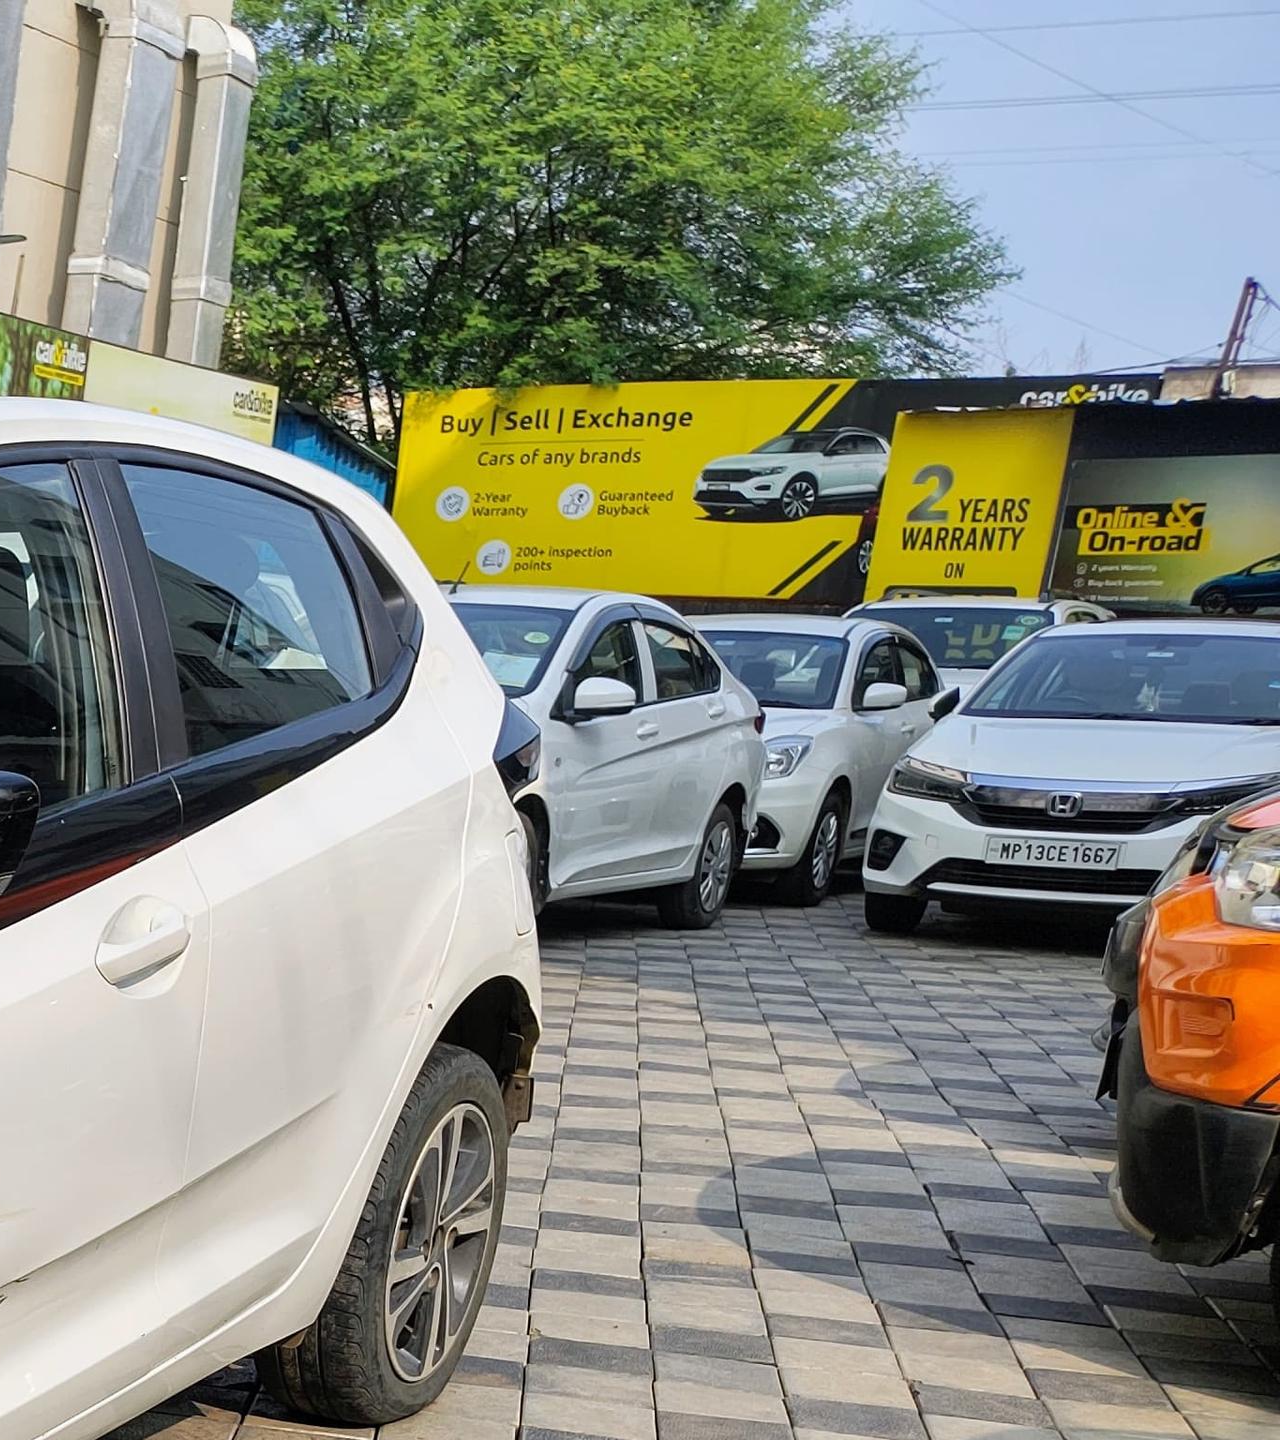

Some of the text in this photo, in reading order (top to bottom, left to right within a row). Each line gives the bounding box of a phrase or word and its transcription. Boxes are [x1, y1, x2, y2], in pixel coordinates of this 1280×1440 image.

[36, 338, 86, 372] car&bike
[441, 415, 484, 437] Buy
[504, 409, 550, 431] Sell
[572, 407, 693, 432] Exchange
[477, 447, 641, 468] Cars of any brands
[473, 492, 511, 503] 2-Year
[599, 489, 674, 502] Guaranteed
[906, 464, 1031, 523] 2 YEARS
[472, 506, 528, 518] Warranty
[597, 504, 650, 517] Buyback
[1076, 498, 1207, 529] Online &
[902, 527, 1025, 551] WARRANTY
[1088, 528, 1203, 552] On-road
[515, 546, 613, 560] 200+ inspection
[513, 561, 552, 573] points
[944, 562, 965, 579] ON
[1000, 843, 1117, 865] MP13CE1667
